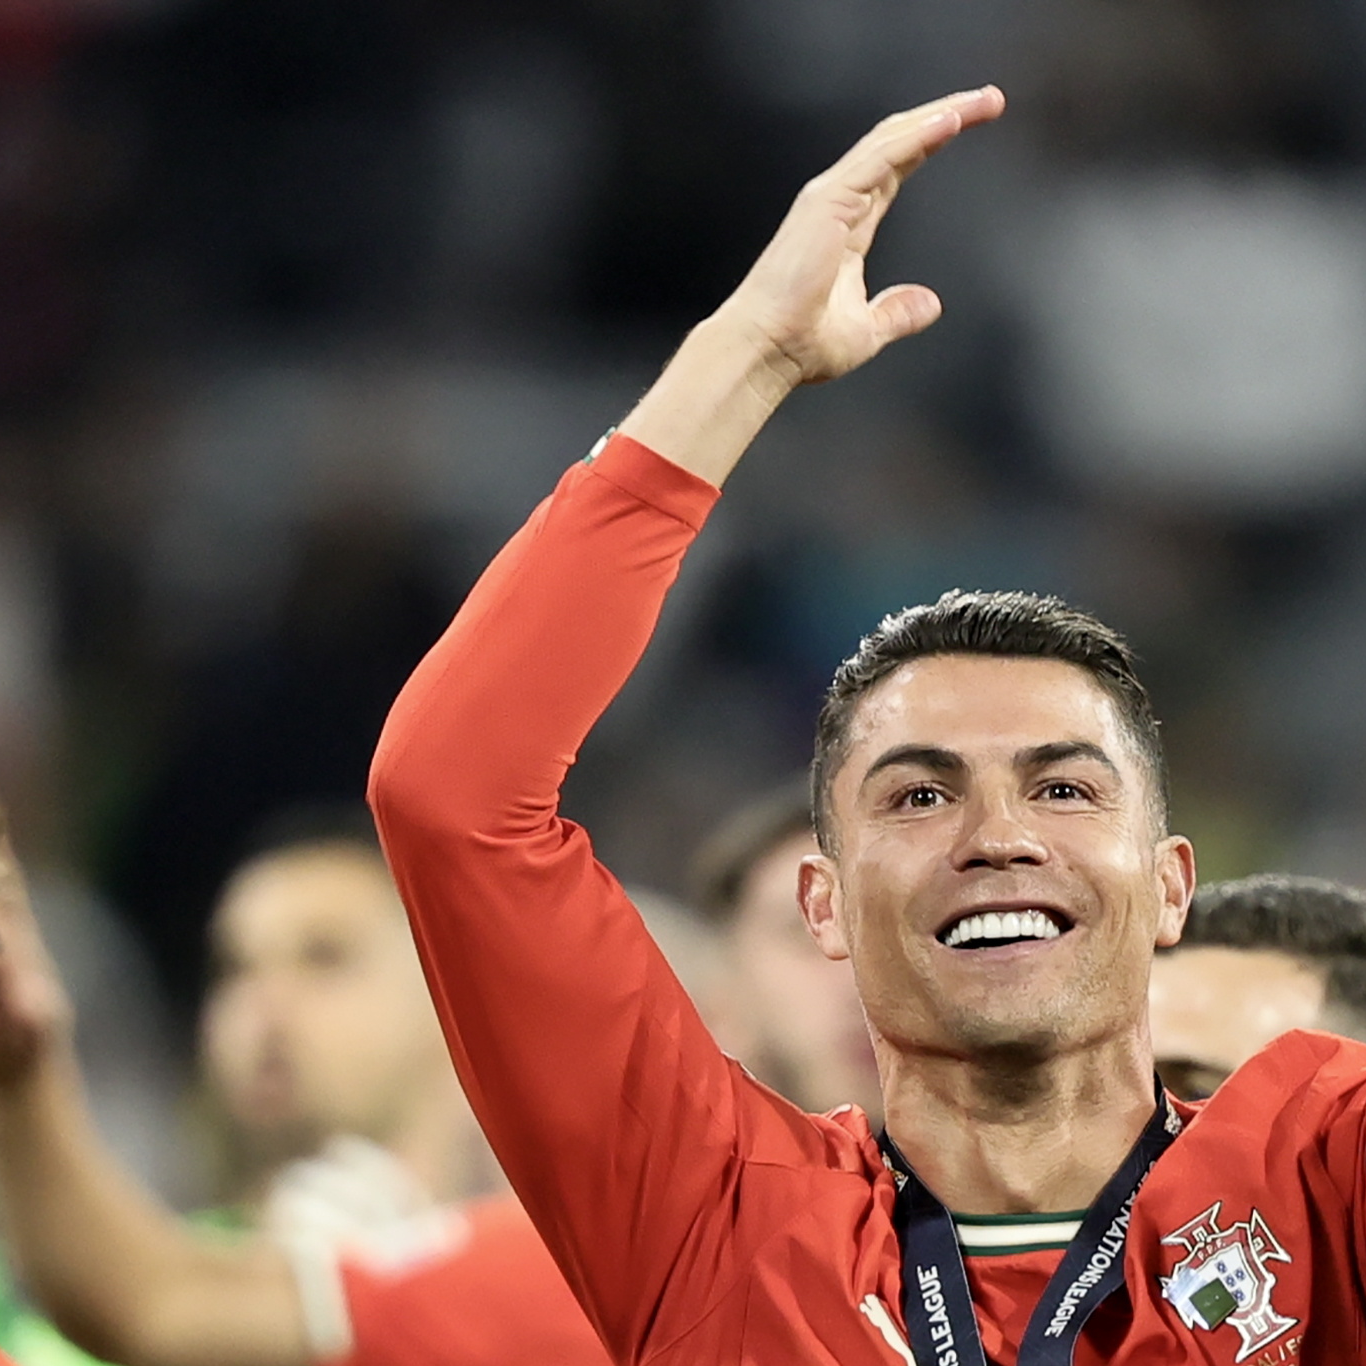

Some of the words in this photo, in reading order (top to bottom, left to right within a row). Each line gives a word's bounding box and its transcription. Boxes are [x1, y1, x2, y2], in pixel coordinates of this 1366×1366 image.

[1079, 1206, 1131, 1284] NATIONS
[916, 1265, 955, 1353] LEAGUE
[1044, 1281, 1093, 1338] LEAGUE
